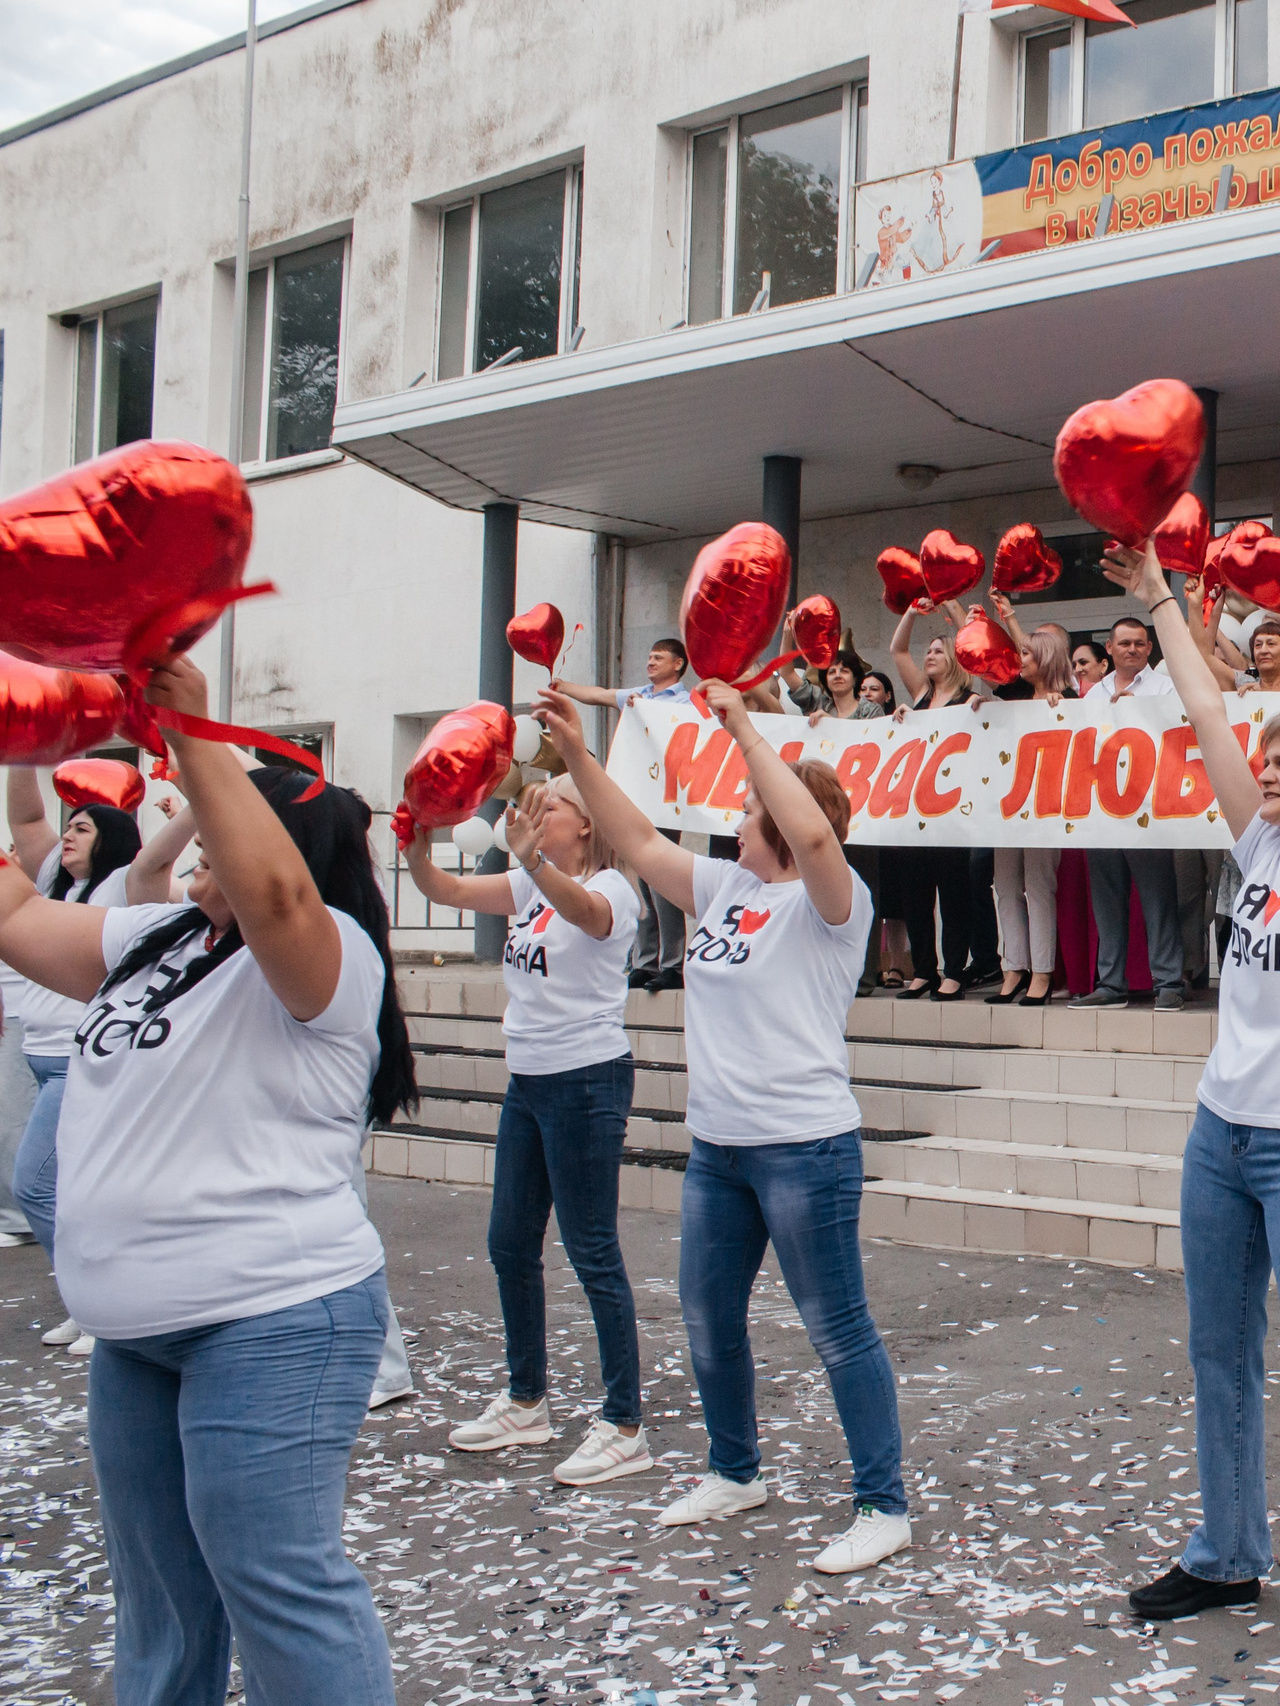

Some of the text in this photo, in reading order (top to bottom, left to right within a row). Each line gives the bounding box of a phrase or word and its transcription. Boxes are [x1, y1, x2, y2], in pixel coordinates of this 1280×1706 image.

[1024, 139, 1153, 211] Добро
[1045, 211, 1067, 246] в
[720, 903, 749, 936] Я
[1236, 883, 1271, 921] Я
